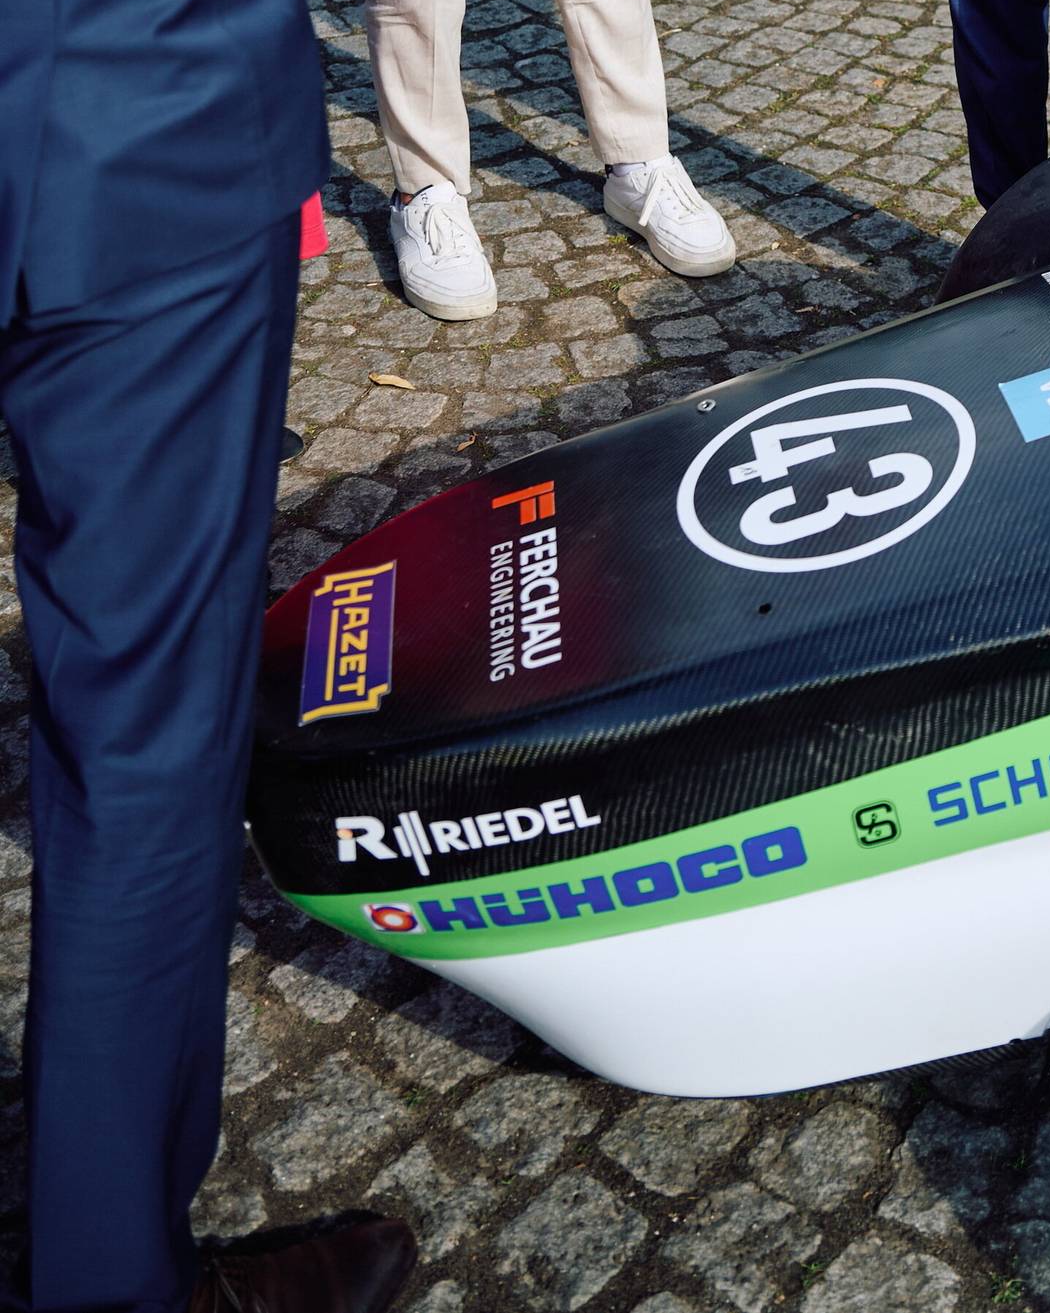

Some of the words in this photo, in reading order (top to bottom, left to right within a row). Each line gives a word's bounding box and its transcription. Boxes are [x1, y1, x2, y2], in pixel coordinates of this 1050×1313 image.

[728, 404, 934, 546] 43
[333, 579, 374, 697] HAZET
[489, 540, 516, 683] ENGINEERING
[519, 527, 563, 671] FERCHAU
[418, 826, 809, 933] HÜHOCO
[429, 794, 602, 854] RIEDEL
